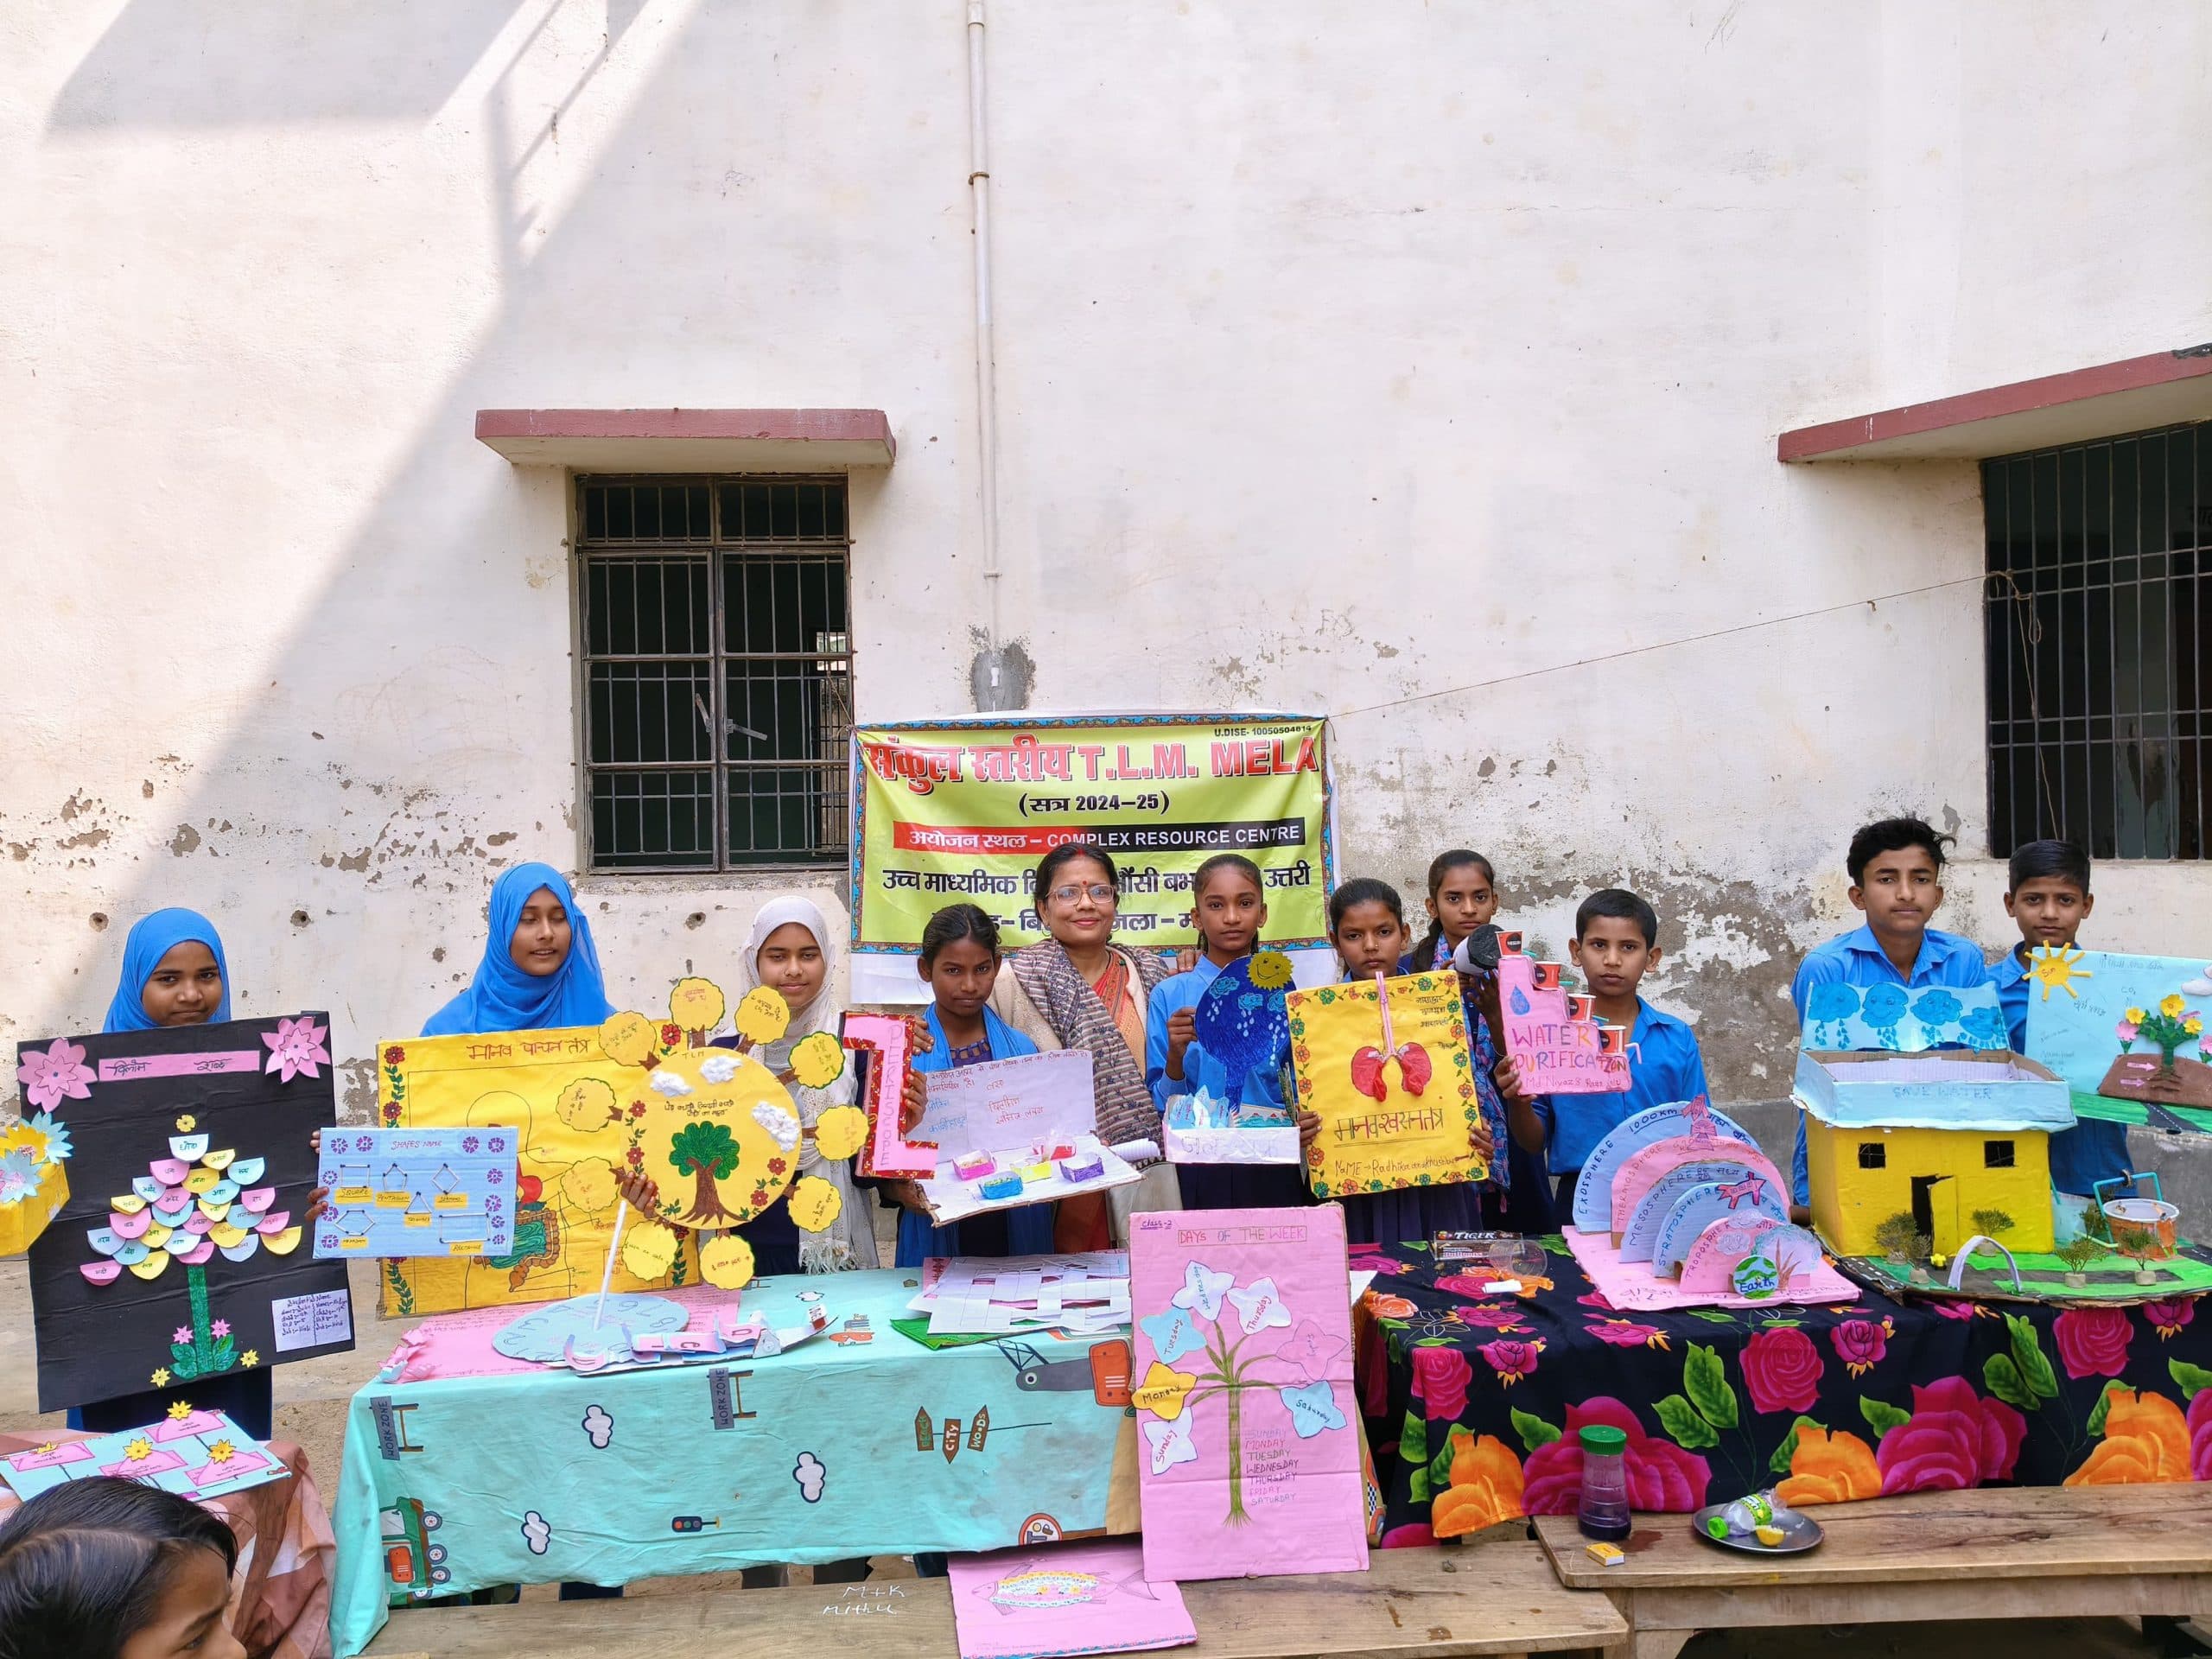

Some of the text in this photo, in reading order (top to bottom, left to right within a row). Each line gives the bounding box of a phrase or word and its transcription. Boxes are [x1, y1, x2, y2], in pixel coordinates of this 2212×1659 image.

[968, 734, 1073, 783] स्तरीय
[1077, 743, 1198, 781] T.L.M.
[1211, 736, 1319, 778] MELA
[1019, 793, 1071, 817] (सत्र
[909, 830, 978, 849] अयोजन
[982, 834, 1028, 849] स्थल
[1046, 831, 1130, 848] COMPLEX
[1135, 828, 1230, 846] RESOURCE
[1236, 825, 1300, 842] CENTRE
[882, 869, 921, 891] उच्च
[923, 868, 1019, 895] माध्यमिक
[1264, 861, 1311, 888] उत्तरी
[1512, 1024, 1592, 1047] WATER
[467, 1038, 591, 1059] मानव पाचन तंत्र
[1630, 1169, 1693, 1246] MESOSPHERE
[1217, 1230, 1230, 1243] OF
[1240, 1229, 1265, 1242] THE
[1269, 1227, 1305, 1240] WEEK
[1740, 1277, 1776, 1293] Earth
[1246, 1295, 1273, 1331] Thursday
[1164, 1319, 1183, 1355] Tuesday
[715, 1368, 728, 1425] WORK ZONE
[1142, 1383, 1182, 1405] Monday
[378, 1400, 394, 1457] WORK ZONE
[1155, 1428, 1178, 1465] Sunday
[1245, 1439, 1286, 1451] MONDAY
[1246, 1449, 1291, 1461] TUESDAY
[1246, 1459, 1299, 1473] WEDNESDAY
[1251, 1493, 1296, 1506] SATURDAY
